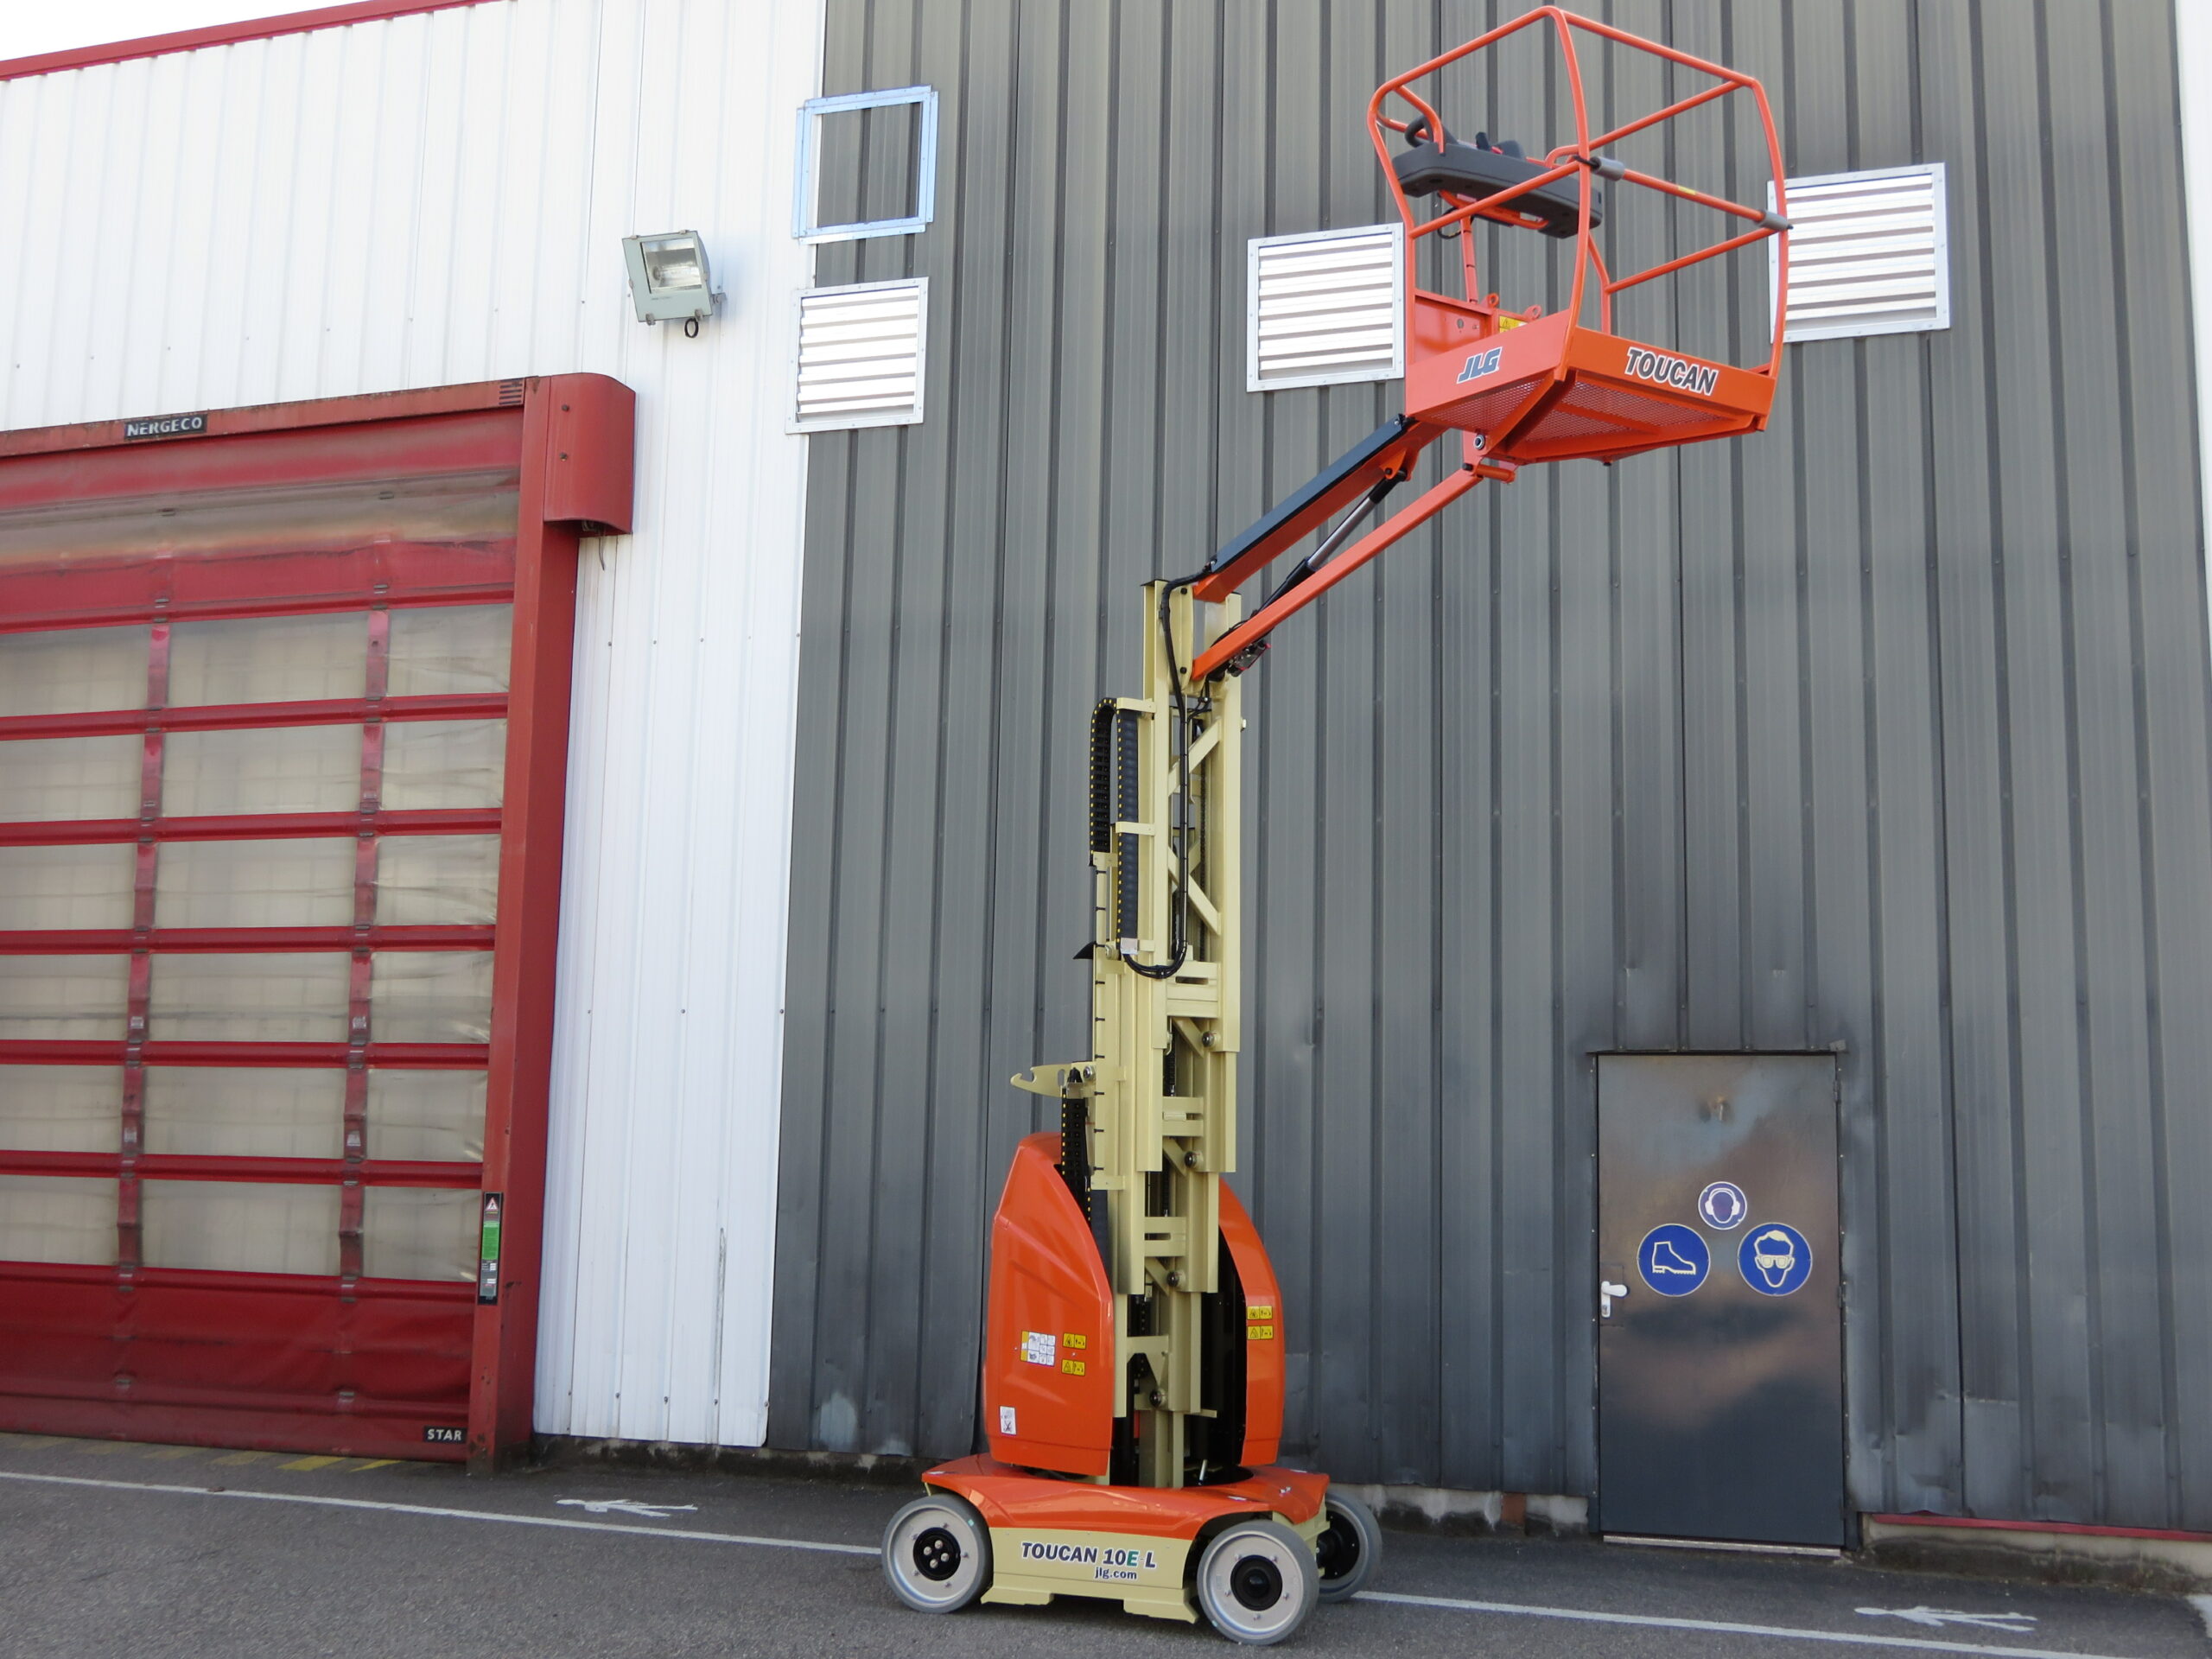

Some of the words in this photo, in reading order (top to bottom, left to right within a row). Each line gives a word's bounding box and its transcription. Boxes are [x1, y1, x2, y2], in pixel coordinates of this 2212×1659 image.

[1457, 346, 1502, 384] JLG
[1624, 346, 1718, 396] TOUCAN
[127, 416, 202, 436] NERGECO
[428, 1428, 461, 1441] STAR
[1021, 1541, 1098, 1564] TOUCAN
[1094, 1567, 1137, 1580] jlg.com
